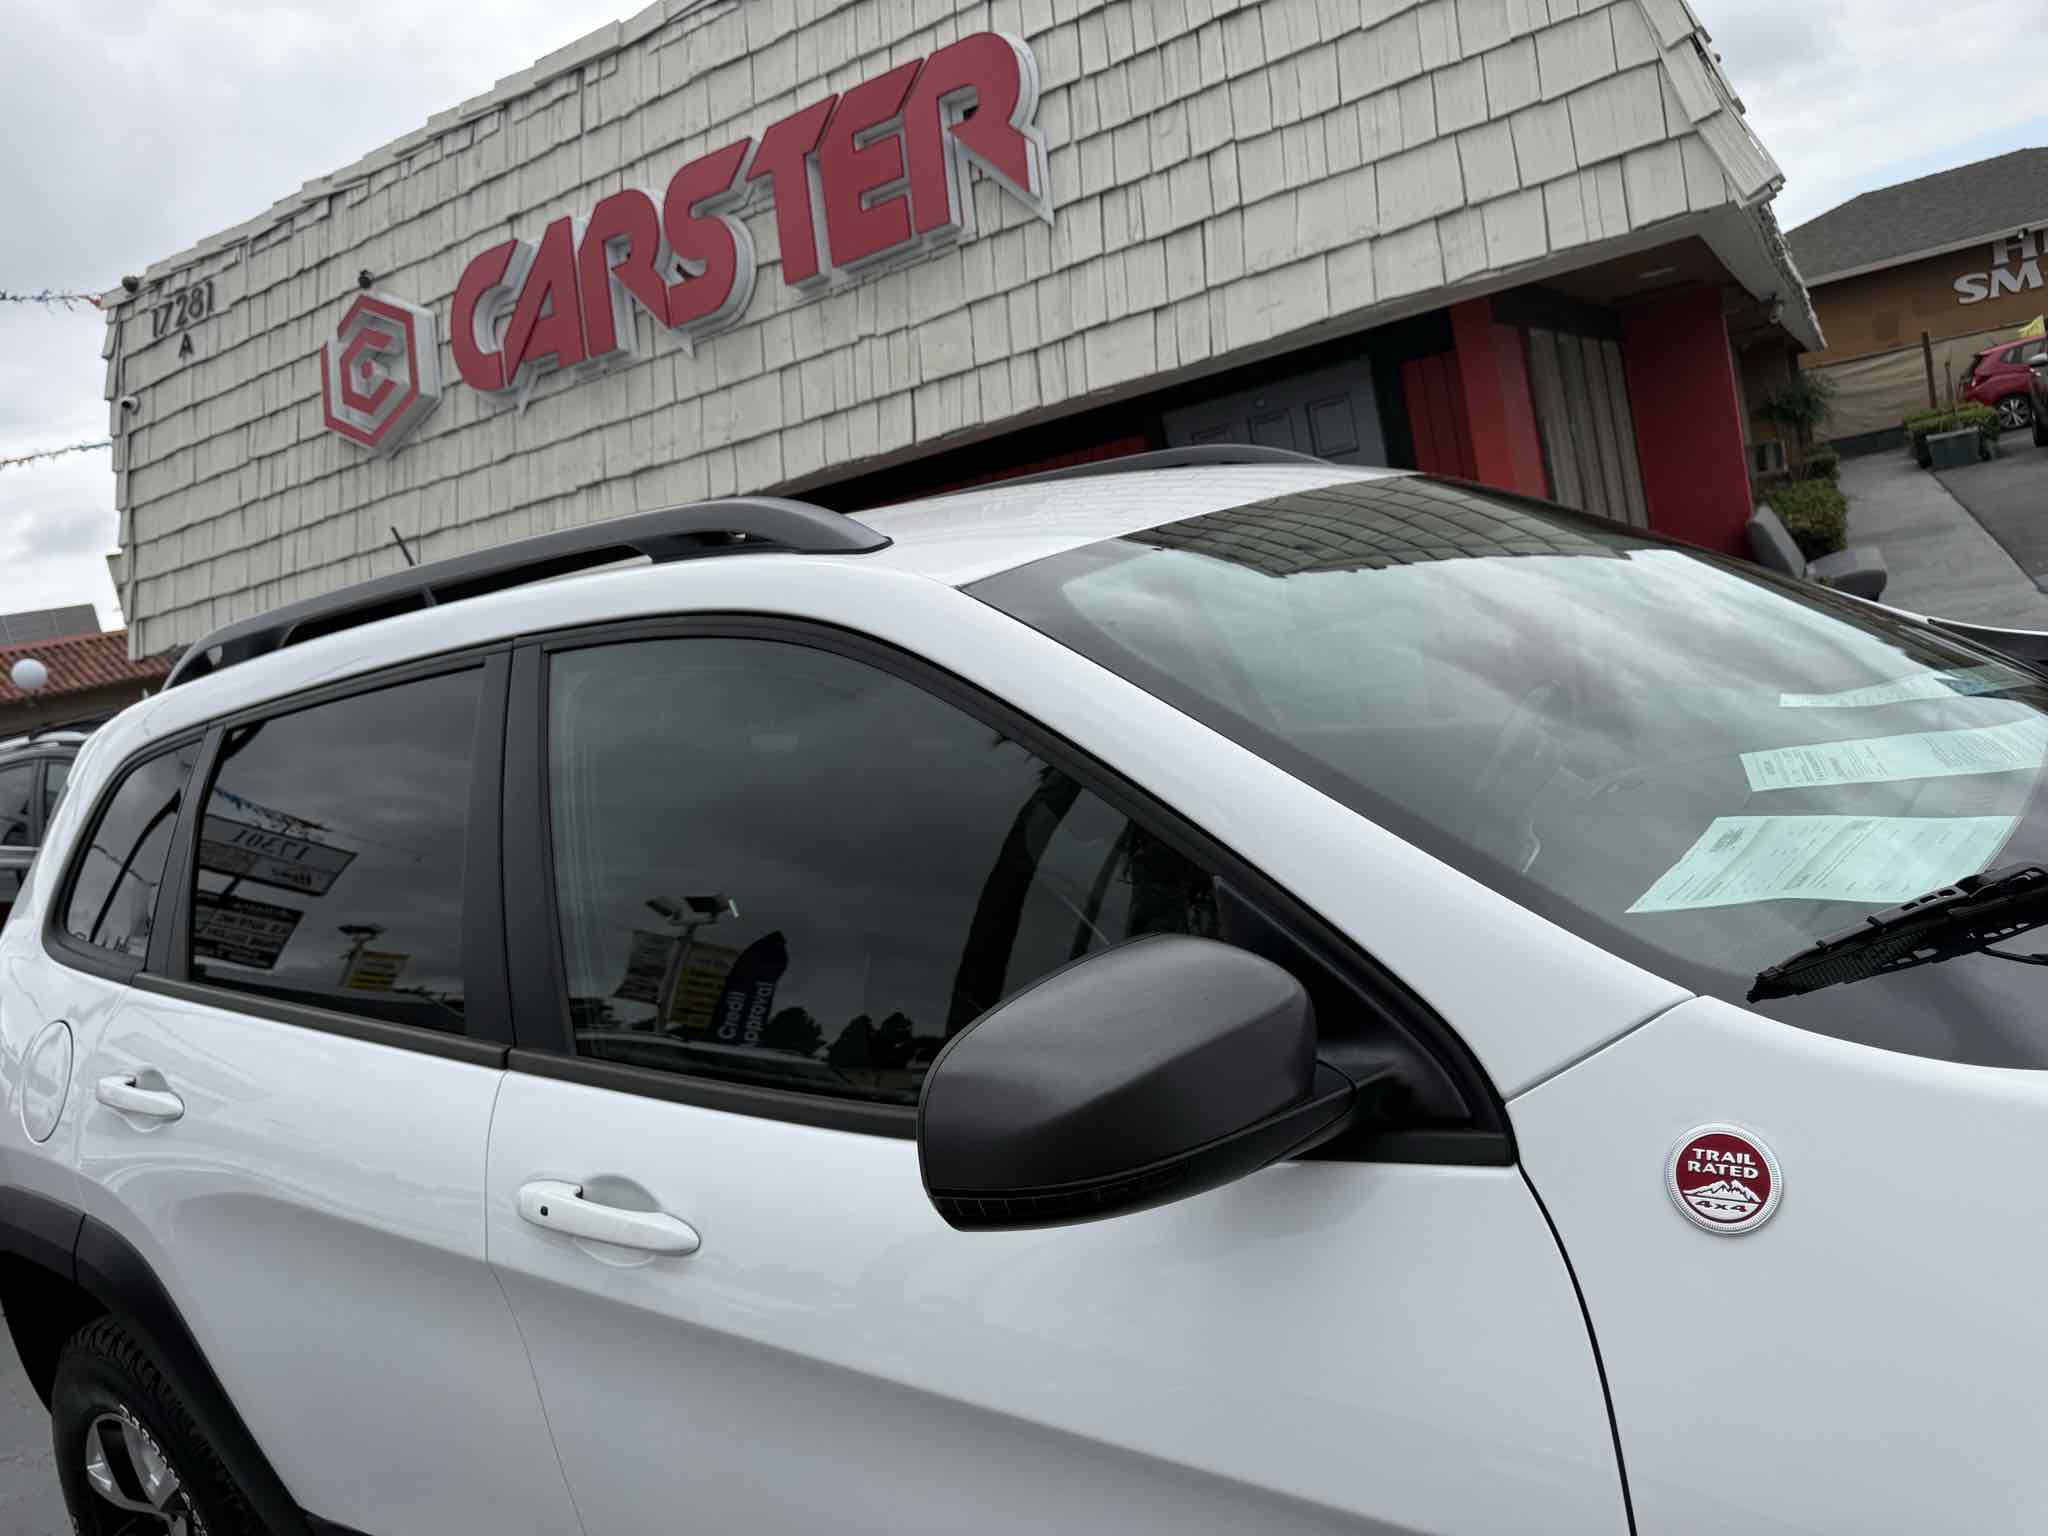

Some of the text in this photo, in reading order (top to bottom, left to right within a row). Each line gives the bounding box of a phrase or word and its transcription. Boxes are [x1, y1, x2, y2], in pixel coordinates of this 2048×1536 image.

[450, 31, 1053, 396] CARSTER
[152, 280, 213, 337] 17281
[178, 332, 195, 358] A
[1687, 1160, 1759, 1179] RATED
[1692, 1148, 1756, 1165] TRAIL
